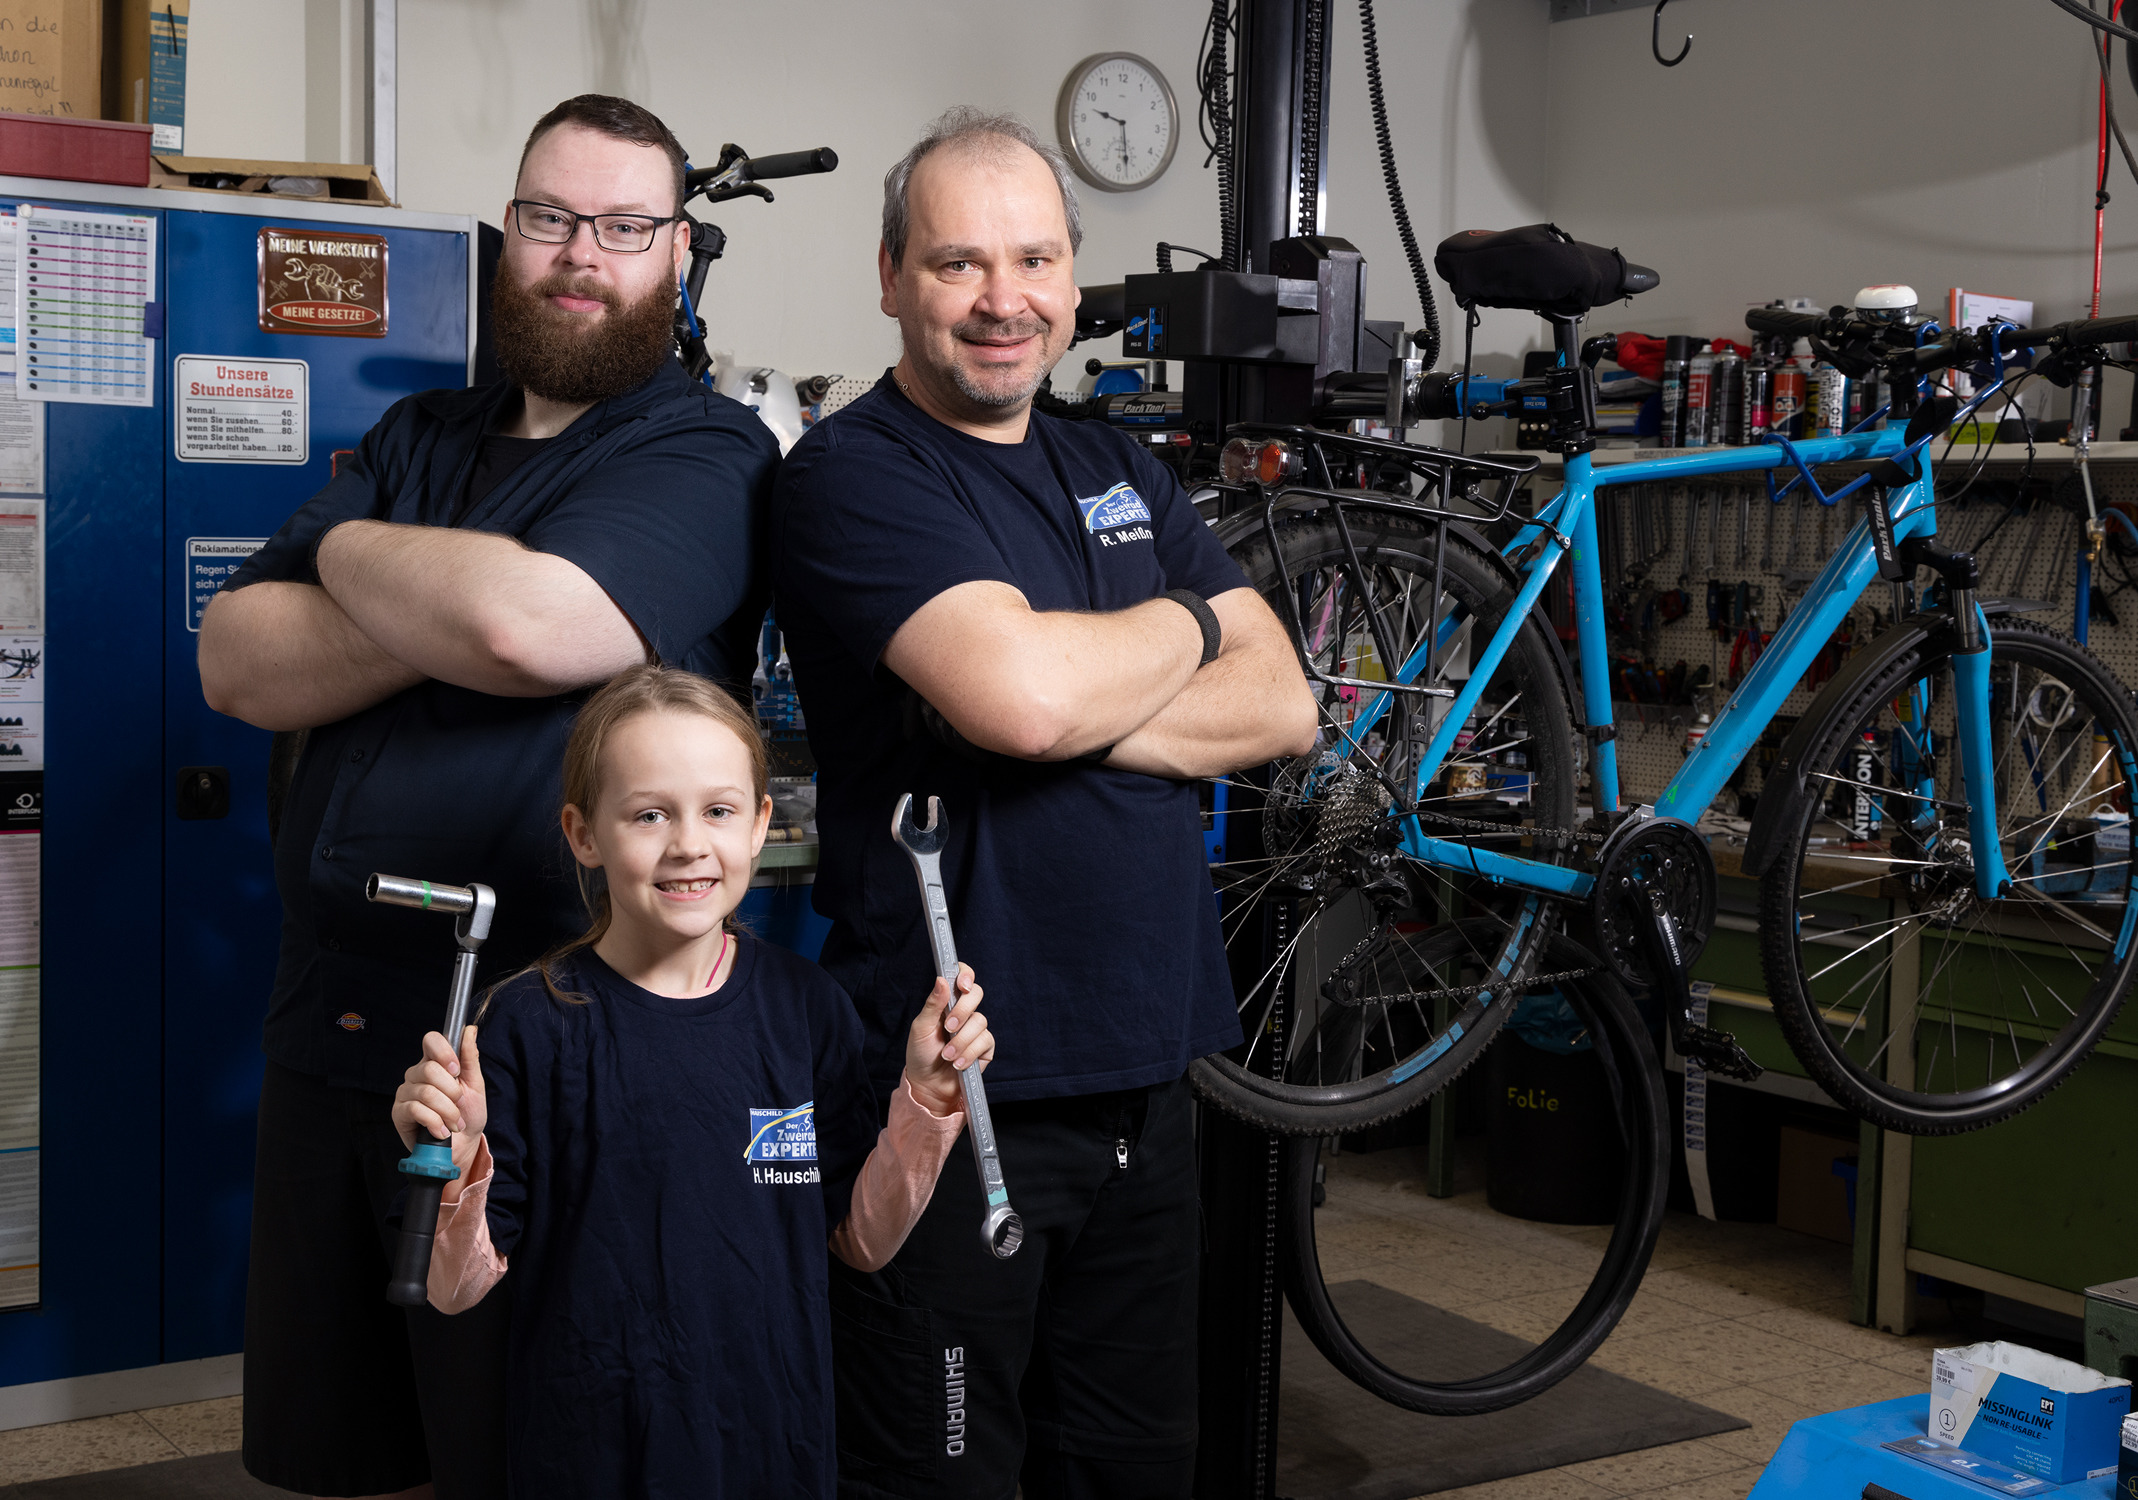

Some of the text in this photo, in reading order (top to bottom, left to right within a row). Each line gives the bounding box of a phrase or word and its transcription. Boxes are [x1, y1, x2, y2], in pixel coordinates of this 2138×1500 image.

[26, 16, 59, 35] die
[1100, 77, 1109, 87] 11
[1118, 73, 1128, 83] 12
[1139, 83, 1143, 92] 1
[1086, 91, 1097, 102] 10
[1150, 101, 1156, 110] 2
[1080, 113, 1087, 122] 9
[1155, 124, 1160, 134] 3
[1085, 137, 1091, 147] 8
[1147, 147, 1153, 155] 4
[1116, 163, 1122, 172] 6
[268, 237, 379, 259] MEINE WERKSTATT
[282, 306, 365, 321] MEINE GESETZE!
[216, 365, 269, 381] Unsere
[190, 381, 294, 399] Stundensätze
[186, 406, 215, 415] Normal
[1124, 403, 1165, 413] Park Tool
[186, 416, 208, 424] wenn
[211, 416, 222, 424] Sie
[225, 417, 259, 426] zusehen
[211, 425, 222, 433] Sie
[226, 426, 264, 434] mithelfen
[186, 442, 239, 451] vorgearbeitet
[242, 444, 266, 452] haben
[1103, 498, 1142, 514] Zweirad
[1098, 508, 1149, 526] EXPERTE
[1872, 499, 1886, 530] Tool
[1099, 534, 1117, 547] R.
[1879, 528, 1893, 562] Park
[195, 564, 225, 576] Regen
[195, 578, 216, 589] sich
[1664, 923, 1681, 966] SHIMANO
[785, 1122, 798, 1130] Der
[761, 1142, 817, 1158] EXPERTE
[945, 1346, 965, 1457] SHIMANO
[2040, 1398, 2054, 1412] EPT
[1944, 1413, 1950, 1426] 1
[1978, 1397, 2054, 1431] MISSINGLINK
[1982, 1413, 2042, 1440] NON RE-USABLE
[1939, 1431, 1955, 1441] SPEED
